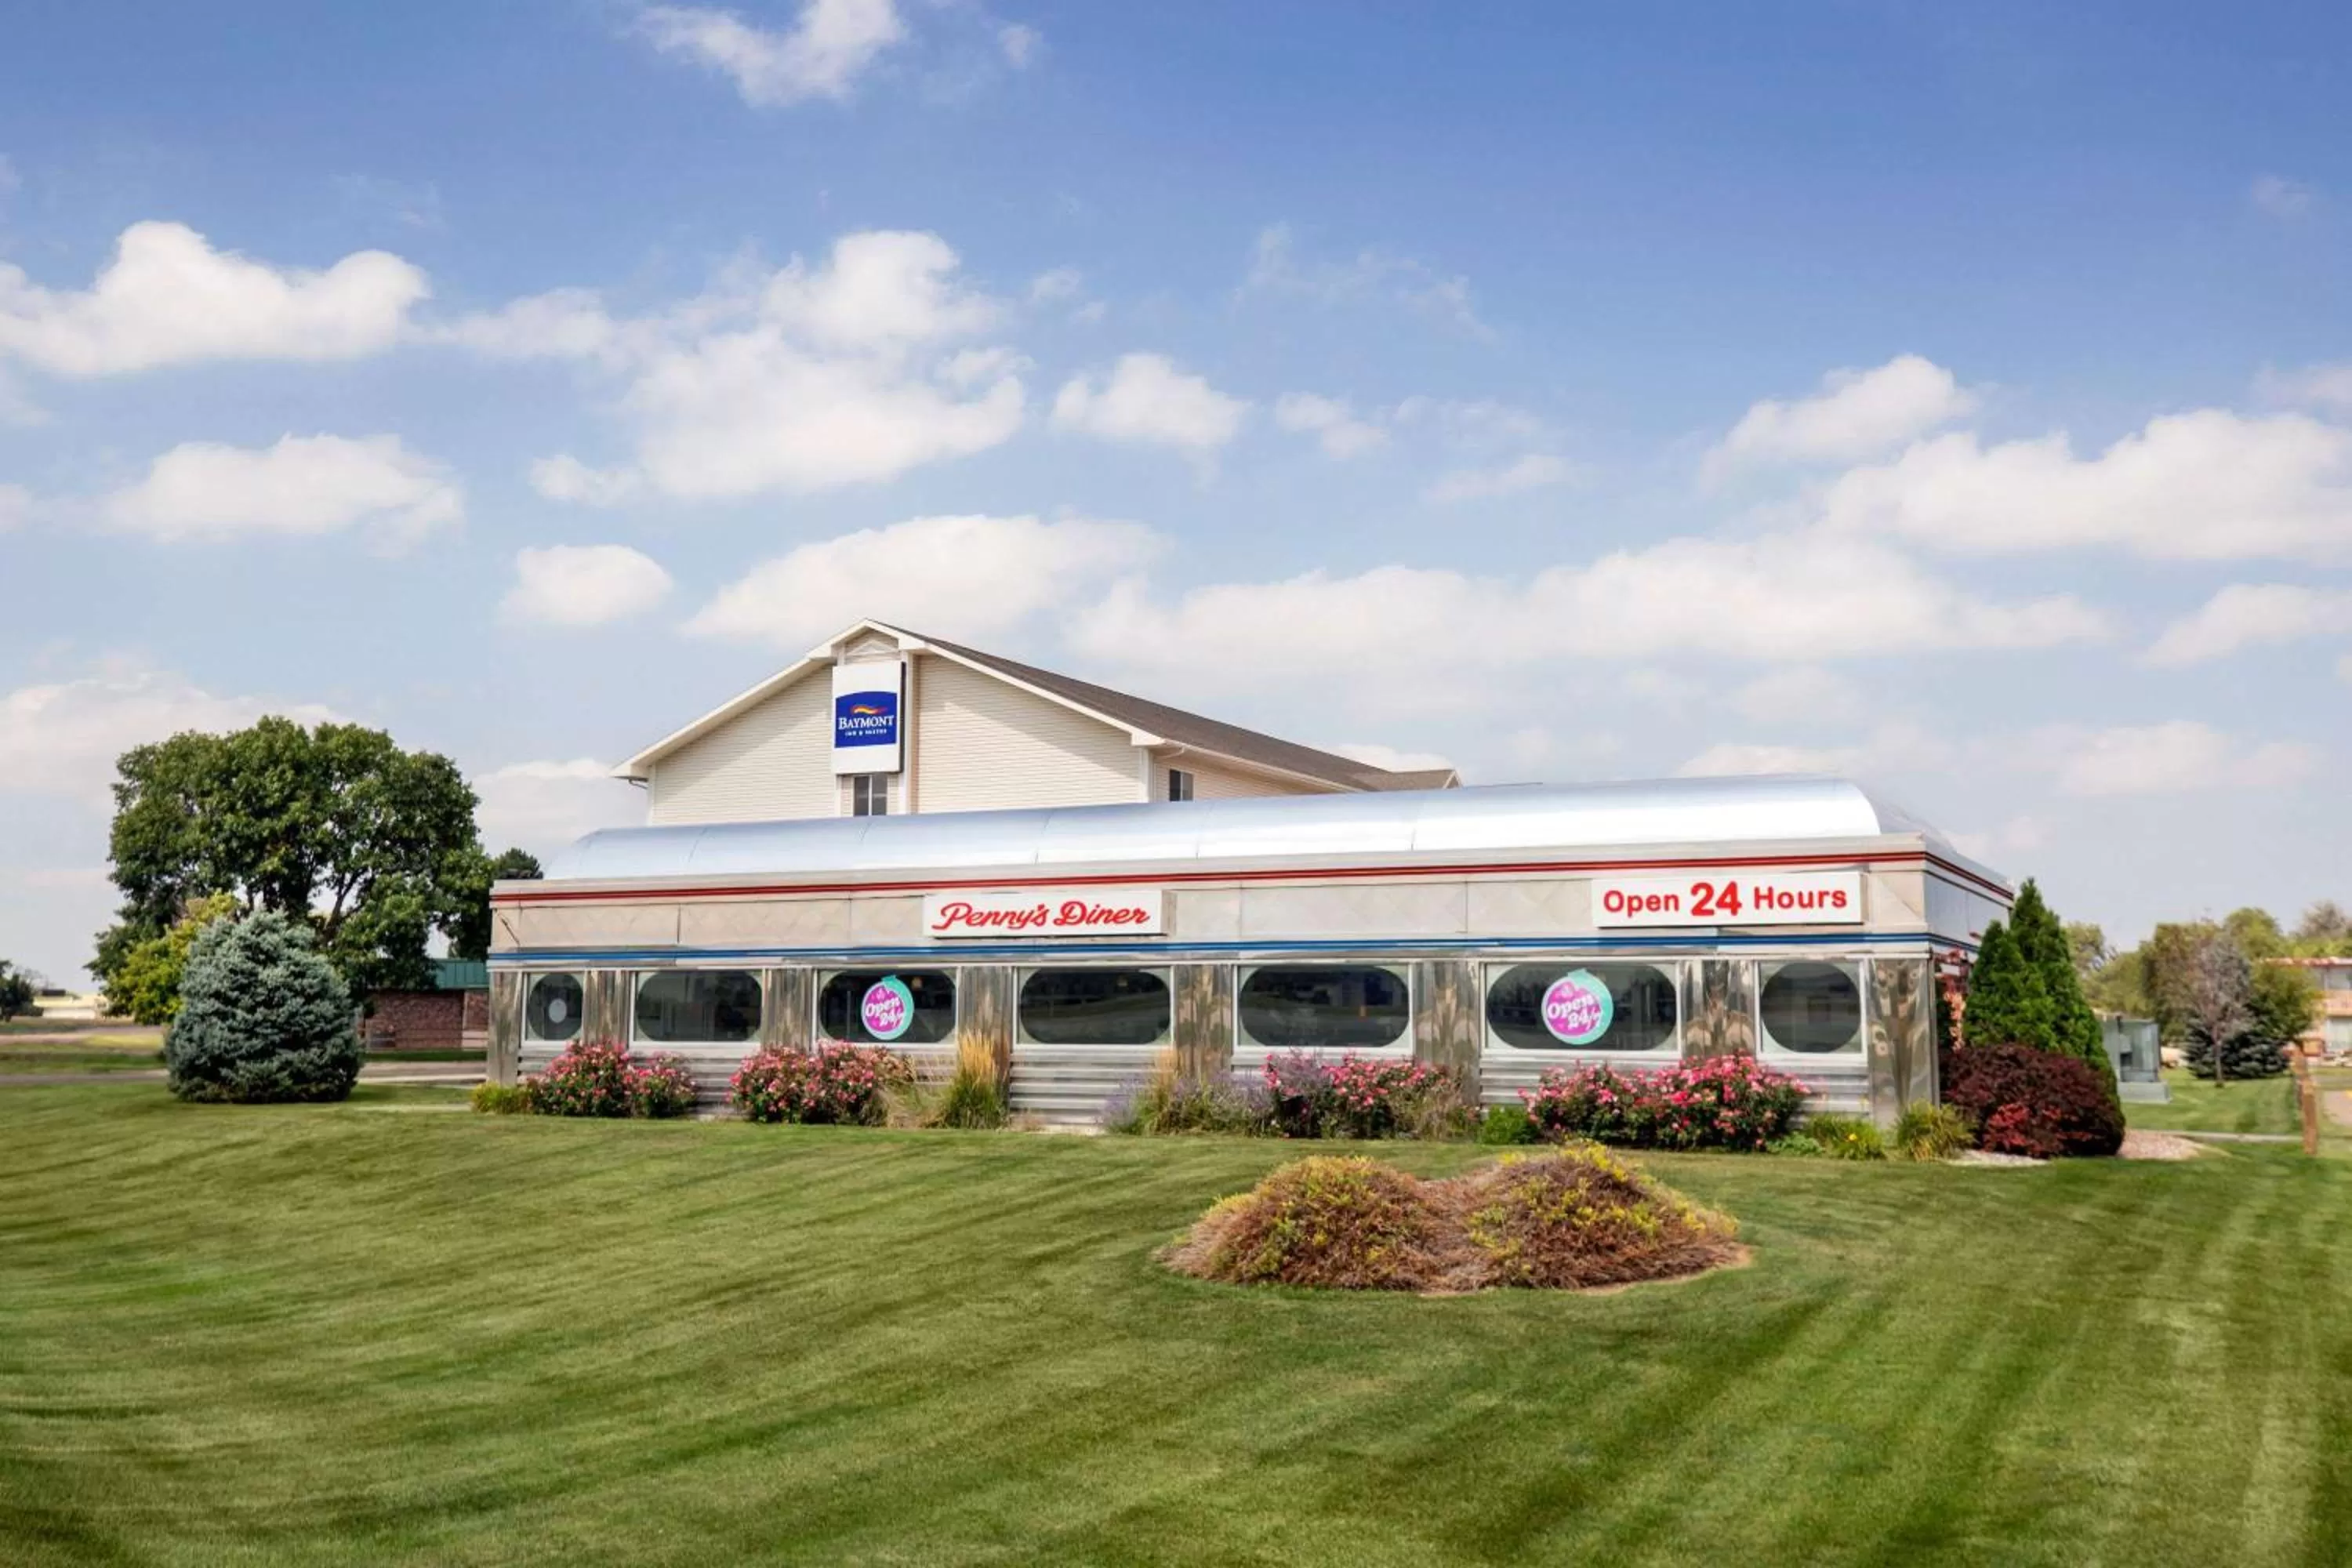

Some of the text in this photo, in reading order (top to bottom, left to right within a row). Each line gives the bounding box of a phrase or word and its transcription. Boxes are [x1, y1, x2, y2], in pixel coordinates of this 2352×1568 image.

[838, 715, 895, 730] BAYMONT
[1603, 880, 1848, 918] Open 24 Hours
[931, 901, 1151, 931] Penny's Diner
